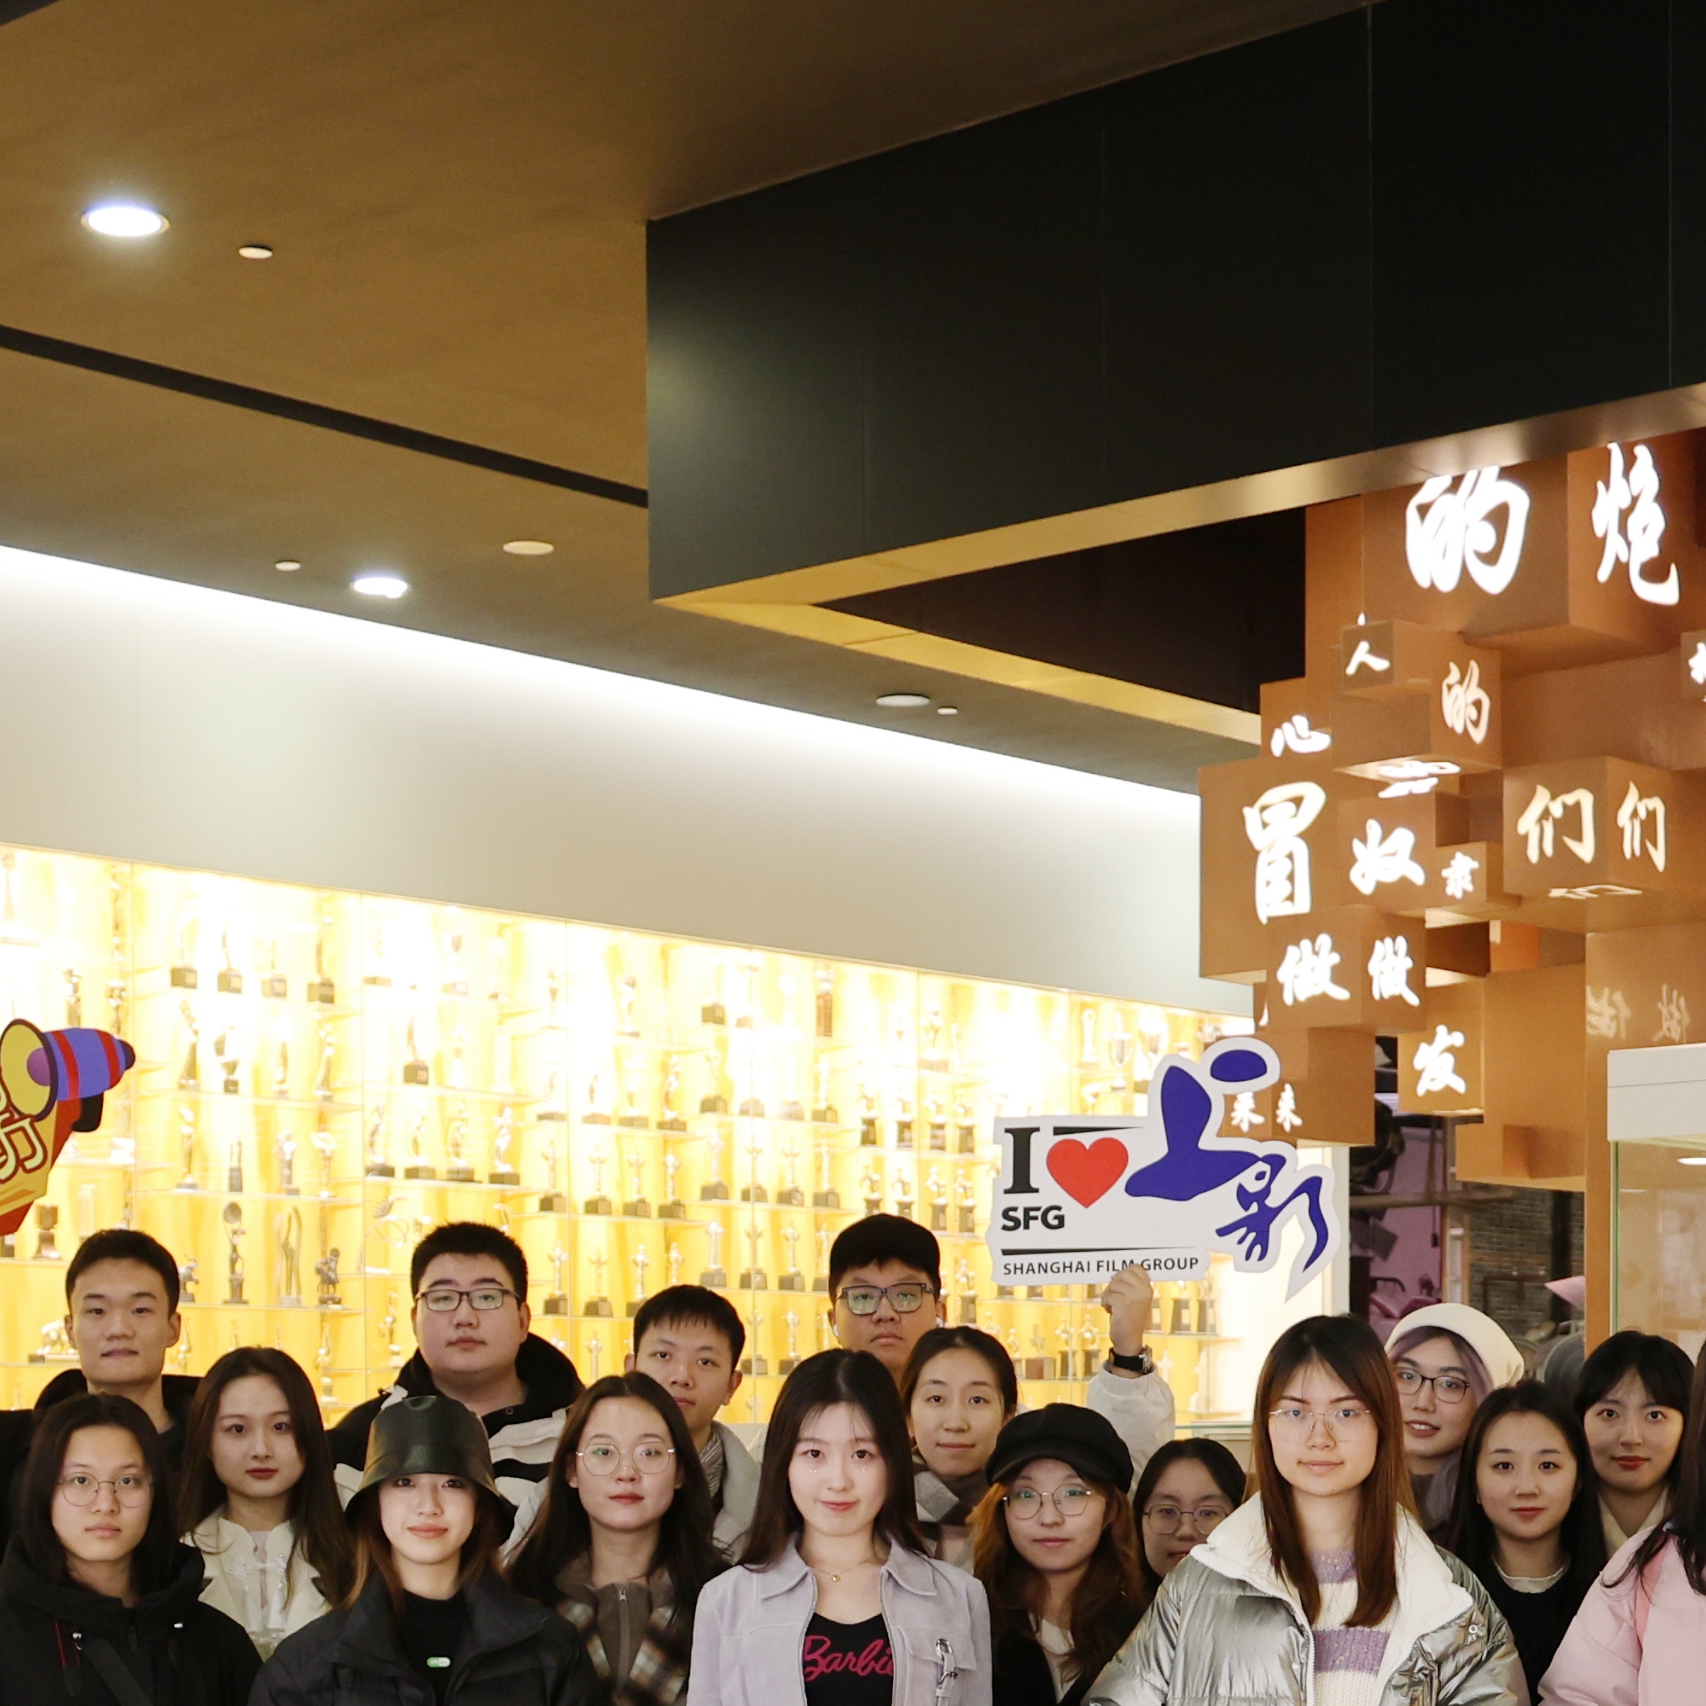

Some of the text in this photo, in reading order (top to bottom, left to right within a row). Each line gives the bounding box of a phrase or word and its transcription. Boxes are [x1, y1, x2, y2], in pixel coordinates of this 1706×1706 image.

[1405, 464, 1531, 594] 的
[1592, 442, 1680, 605] 炮
[1517, 785, 1595, 864] 们
[1617, 782, 1666, 872] 们
[1002, 1126, 1041, 1195] I
[1000, 1204, 1066, 1232] SFG
[1002, 1259, 1092, 1276] SHANGHAI
[1139, 1255, 1200, 1272] GROUP
